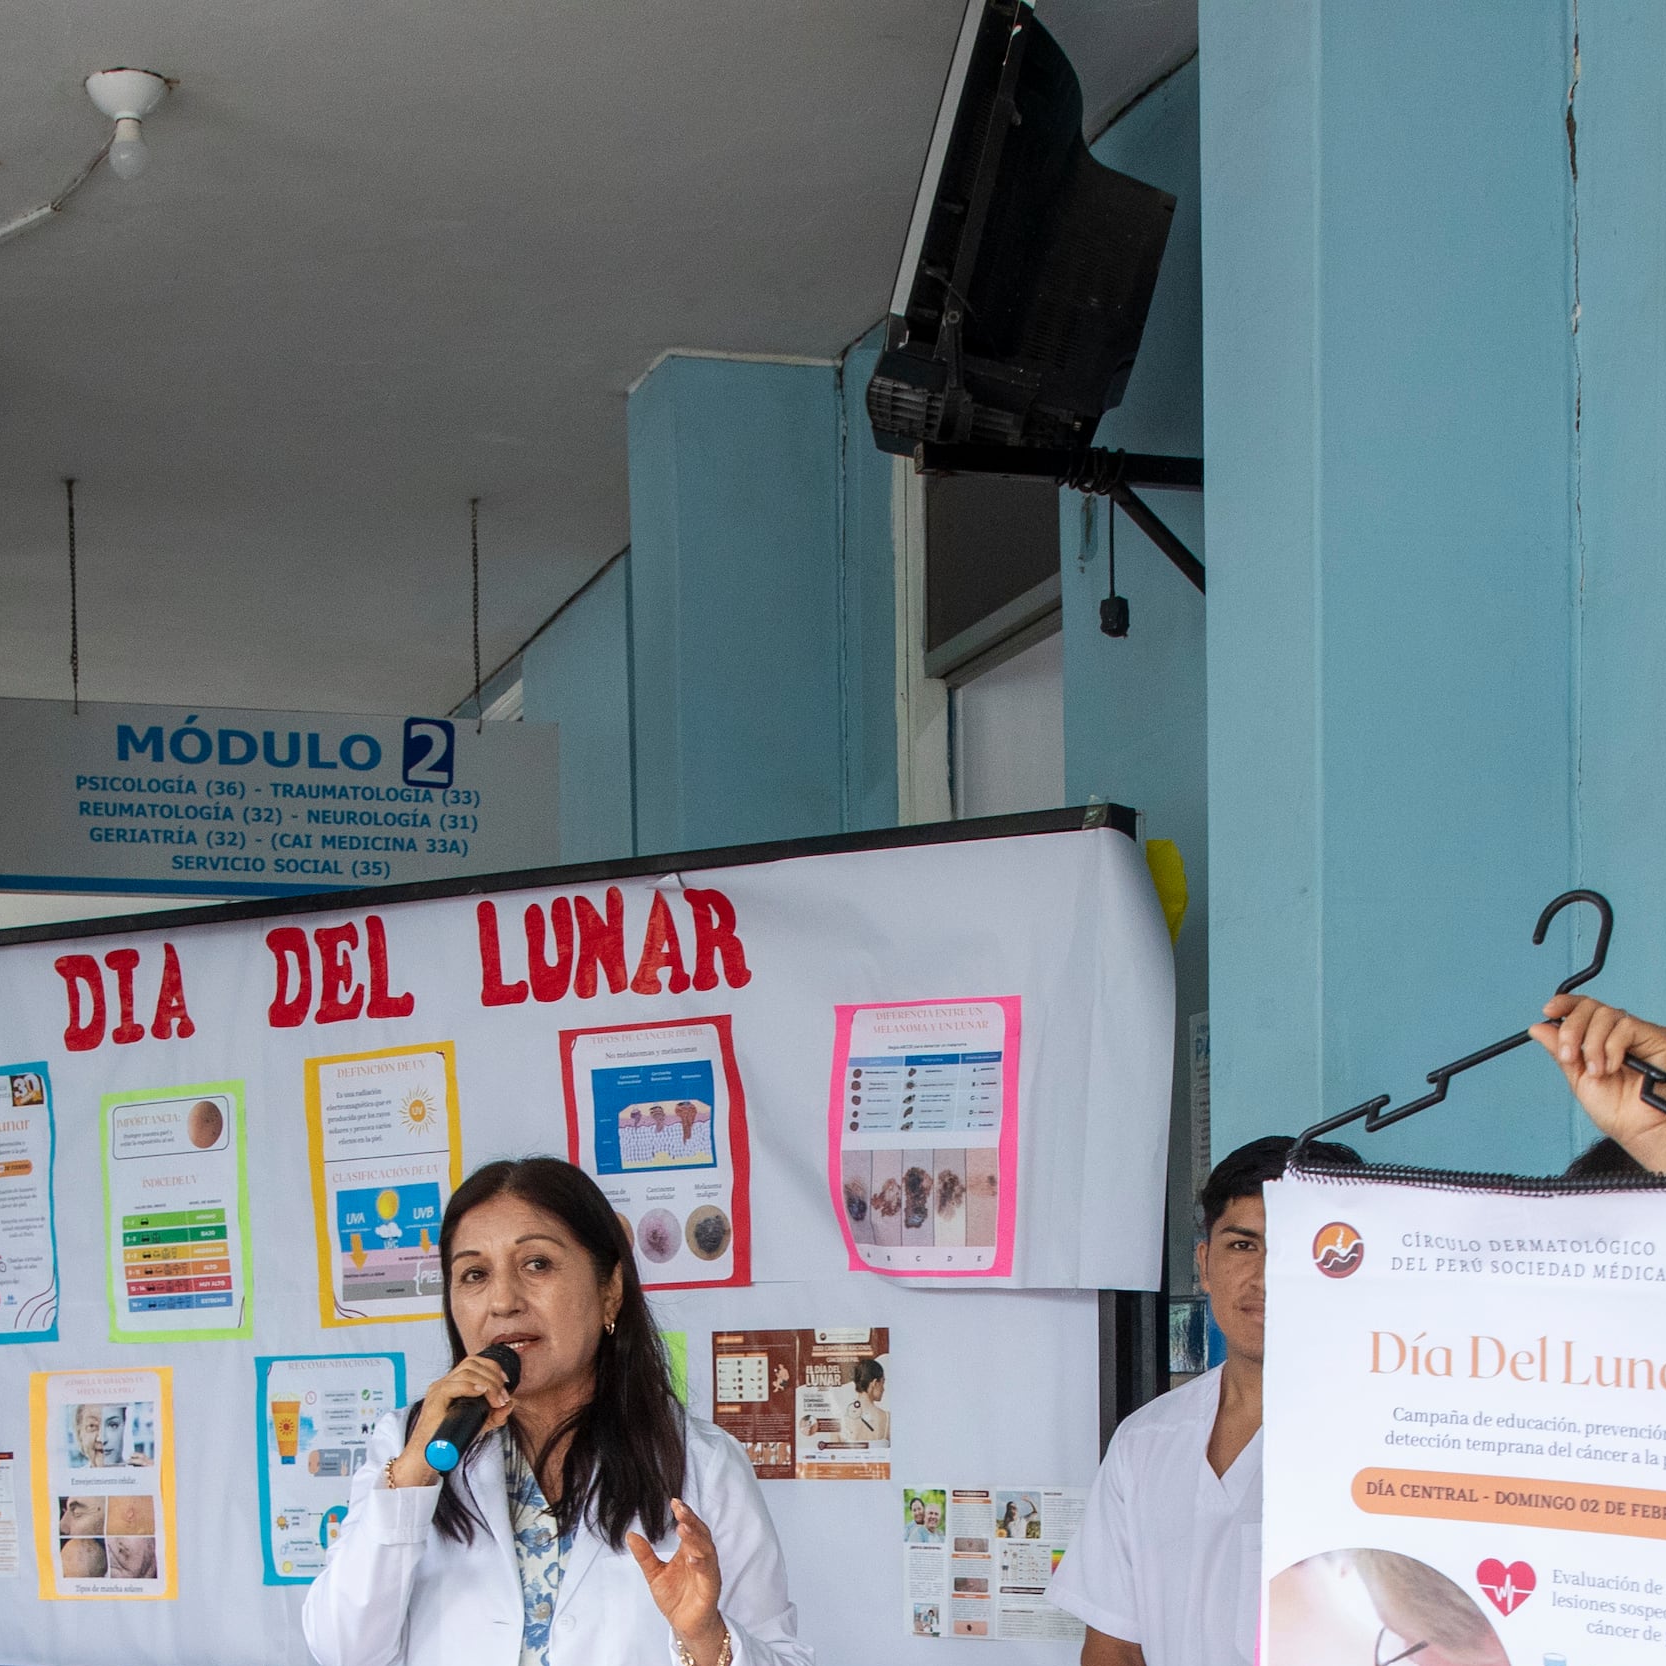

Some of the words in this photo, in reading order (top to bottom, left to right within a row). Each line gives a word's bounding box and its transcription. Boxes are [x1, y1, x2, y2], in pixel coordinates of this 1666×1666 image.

[117, 714, 382, 771] MÓDULO
[407, 723, 449, 784] 2
[76, 775, 197, 794] PSICOLOGÍA
[206, 780, 246, 799] (36)
[442, 789, 480, 808] (33)
[79, 801, 233, 820] REUMATOLOGÍA
[243, 806, 282, 825] (32)
[307, 808, 431, 828] NEUROLOGÍA
[440, 815, 478, 833] (31)
[89, 826, 197, 845] GERIATRÍA
[206, 831, 246, 849] (32)
[271, 832, 312, 850] (CAI
[321, 835, 417, 851] MEDICINA
[426, 838, 468, 857] 33A)
[172, 855, 265, 872] SERVICIO
[274, 858, 343, 874] SOCIAL
[352, 861, 390, 879] (35)
[54, 941, 196, 1052] DIA
[266, 914, 415, 1030] DEL
[477, 885, 752, 1008] LUNAR
[935, 1007, 967, 1018] ENTRE
[969, 1006, 983, 1016] UN
[346, 1213, 366, 1224] UVA
[413, 1206, 434, 1219] UVB
[1401, 1231, 1481, 1252] CÍRCULO
[1488, 1237, 1655, 1256] DERMATOLÓGICO
[420, 1270, 442, 1283] PIEL
[1391, 1257, 1427, 1272] DEL
[1435, 1257, 1483, 1273] PERÚ
[1491, 1260, 1586, 1278] SOCIEDAD
[1592, 1262, 1666, 1282] MÉDICA
[1370, 1331, 1453, 1377] Día
[1469, 1335, 1548, 1382] Del
[806, 1374, 841, 1387] LUNAR
[1393, 1406, 1469, 1427] Campaña
[1473, 1411, 1492, 1427] de
[1385, 1430, 1461, 1450] detección
[1466, 1437, 1544, 1456] temprana
[1548, 1441, 1572, 1458] del
[1576, 1444, 1628, 1462] cáncer
[1631, 1453, 1640, 1464] a
[1645, 1449, 1659, 1465] la
[1365, 1479, 1396, 1496] DÍA
[1400, 1483, 1479, 1503] CENTRAL
[1495, 1490, 1575, 1511] DOMINGO
[1580, 1498, 1599, 1513] 02
[1604, 1500, 1626, 1515] DE
[1552, 1568, 1640, 1593] Evaluación
[1644, 1578, 1663, 1596] de
[1551, 1591, 1616, 1614] lesiones
[1586, 1619, 1639, 1640] cáncer
[1642, 1625, 1662, 1643] de
